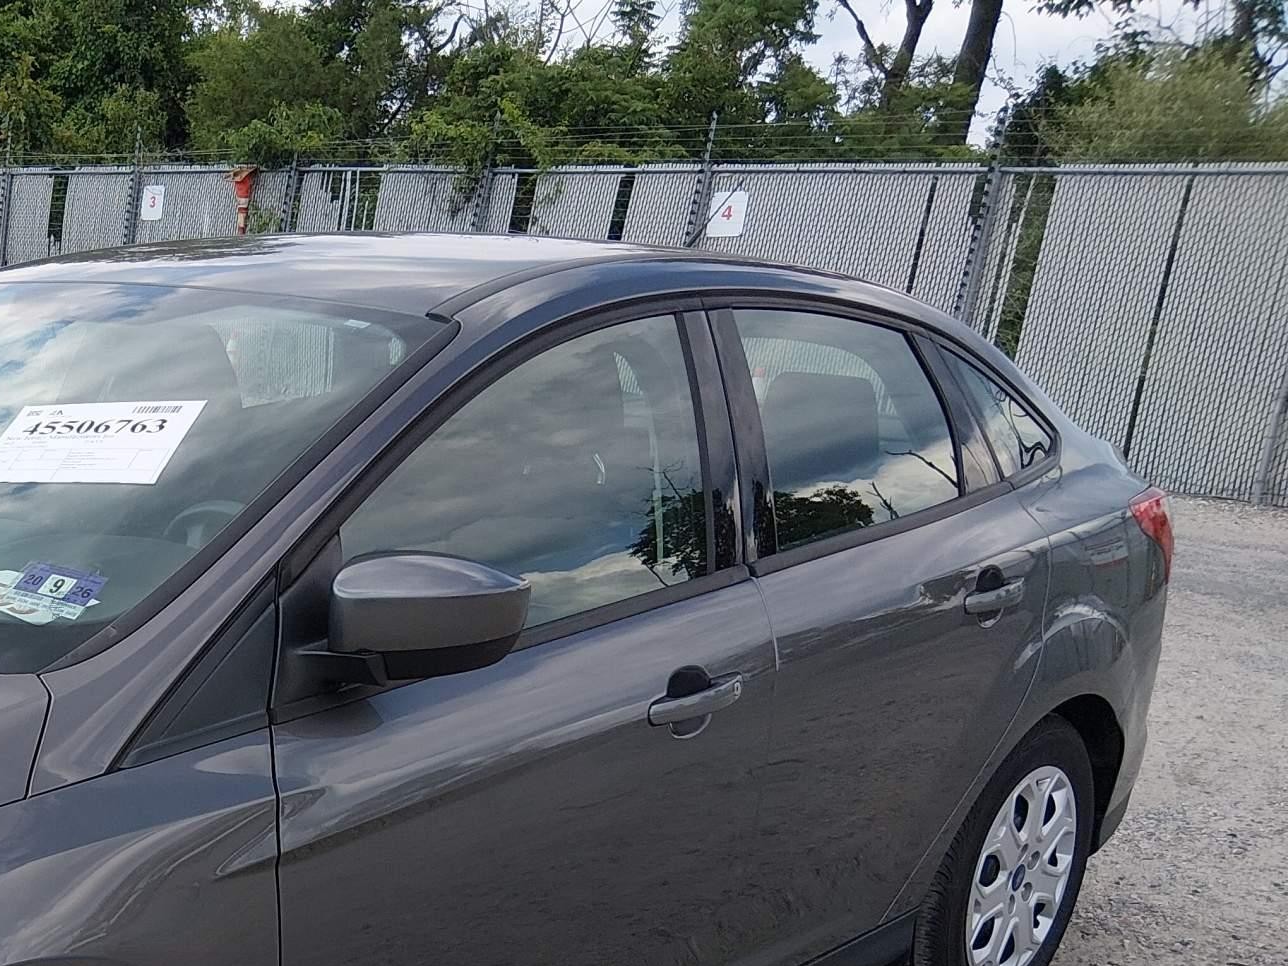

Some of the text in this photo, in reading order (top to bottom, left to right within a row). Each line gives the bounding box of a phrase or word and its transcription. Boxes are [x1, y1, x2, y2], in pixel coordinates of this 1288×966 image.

[149, 196, 156, 208] 3
[721, 205, 733, 220] 4
[22, 418, 168, 435] 45506763
[24, 574, 43, 585] 20
[49, 579, 65, 593] 9
[72, 586, 93, 598] 26
